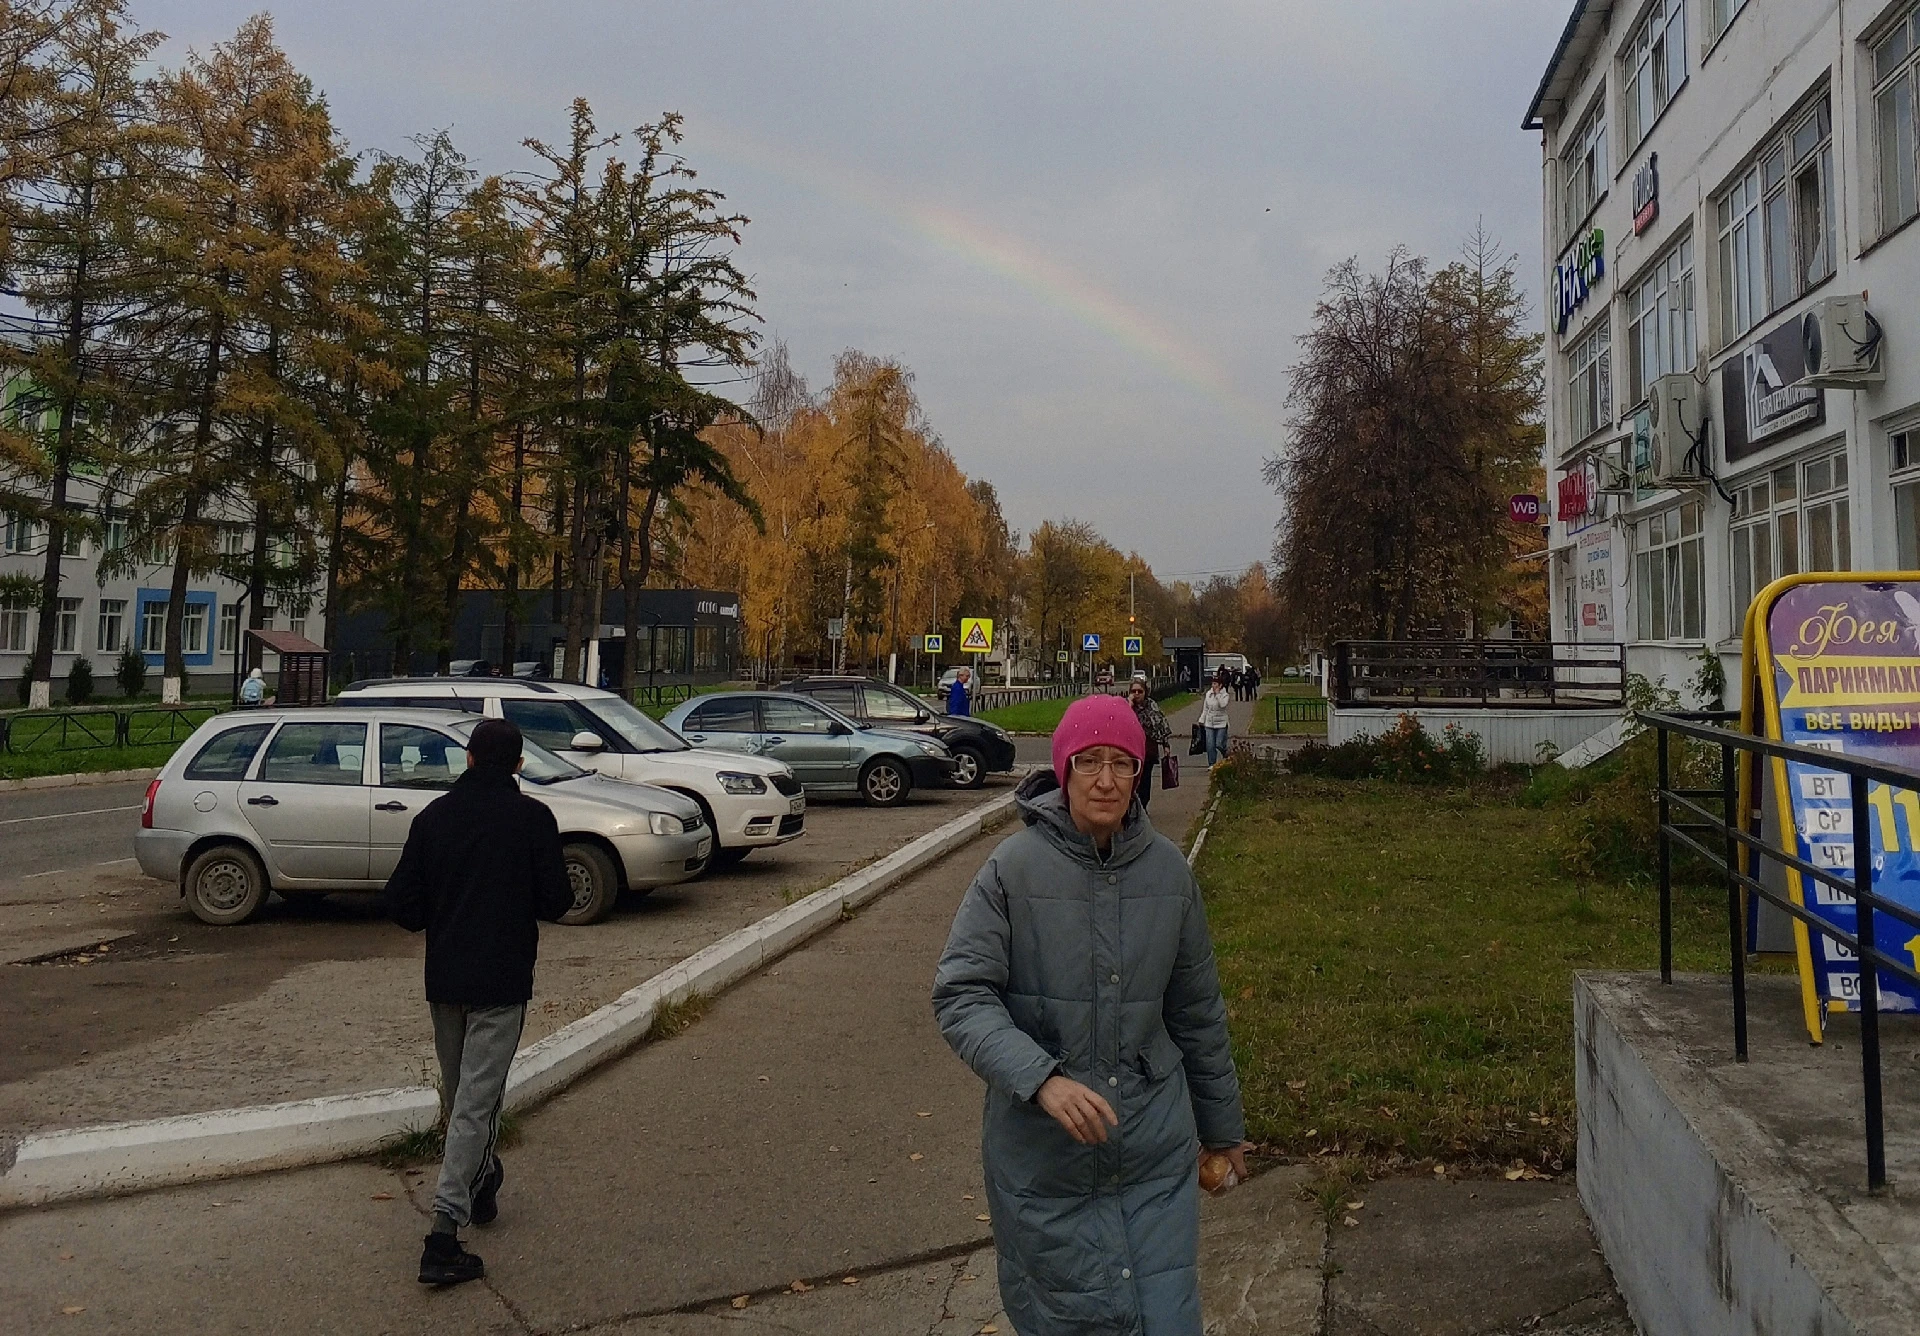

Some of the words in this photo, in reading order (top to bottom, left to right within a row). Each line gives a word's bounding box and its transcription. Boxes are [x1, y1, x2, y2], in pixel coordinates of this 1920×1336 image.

[1512, 501, 1538, 514] WB
[1790, 602, 1900, 661] Фея
[1805, 712, 1843, 730] ВСЕ
[1849, 712, 1911, 733] ВИДЫ
[1812, 777, 1835, 796] ВТ
[1818, 811, 1842, 830] СР
[1823, 845, 1846, 866] ЧТ
[1836, 940, 1859, 957] С
